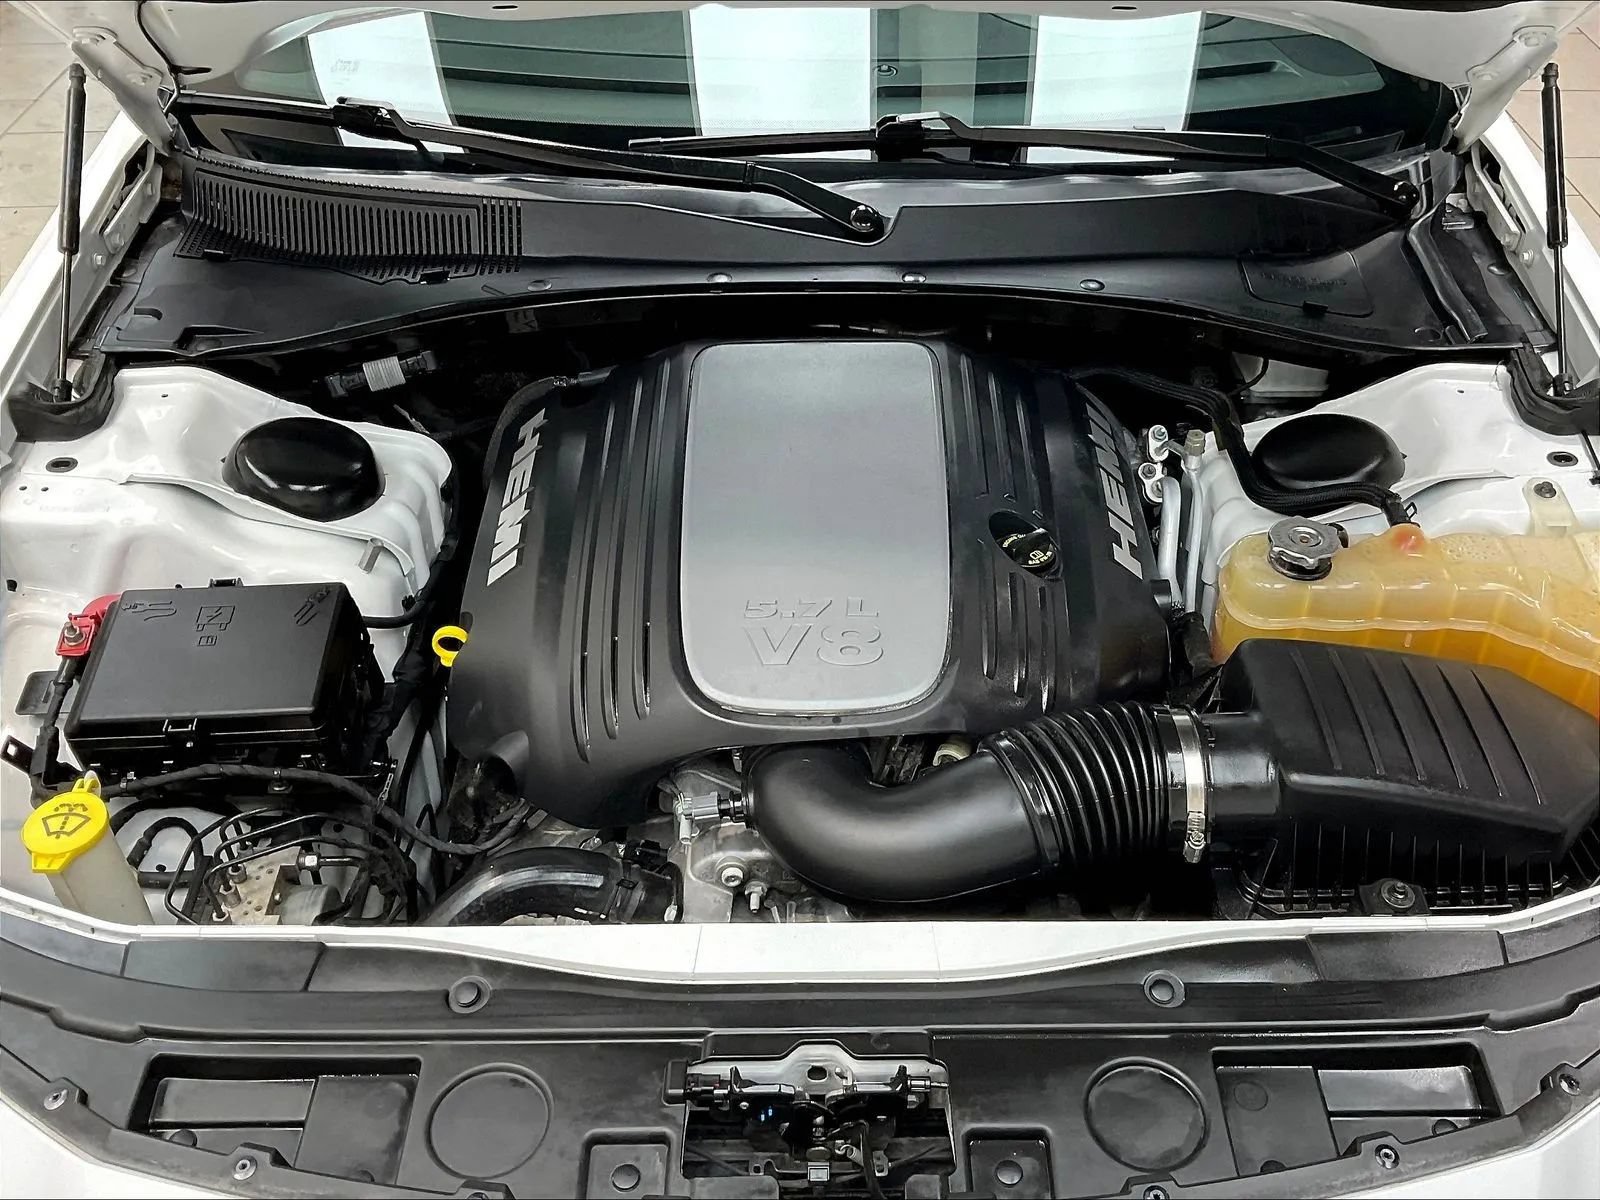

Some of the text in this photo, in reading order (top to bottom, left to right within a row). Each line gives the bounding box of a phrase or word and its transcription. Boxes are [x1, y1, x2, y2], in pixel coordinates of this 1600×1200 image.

[486, 407, 547, 587] HEMI
[1085, 402, 1143, 580] HEMI
[741, 622, 885, 667] V8
